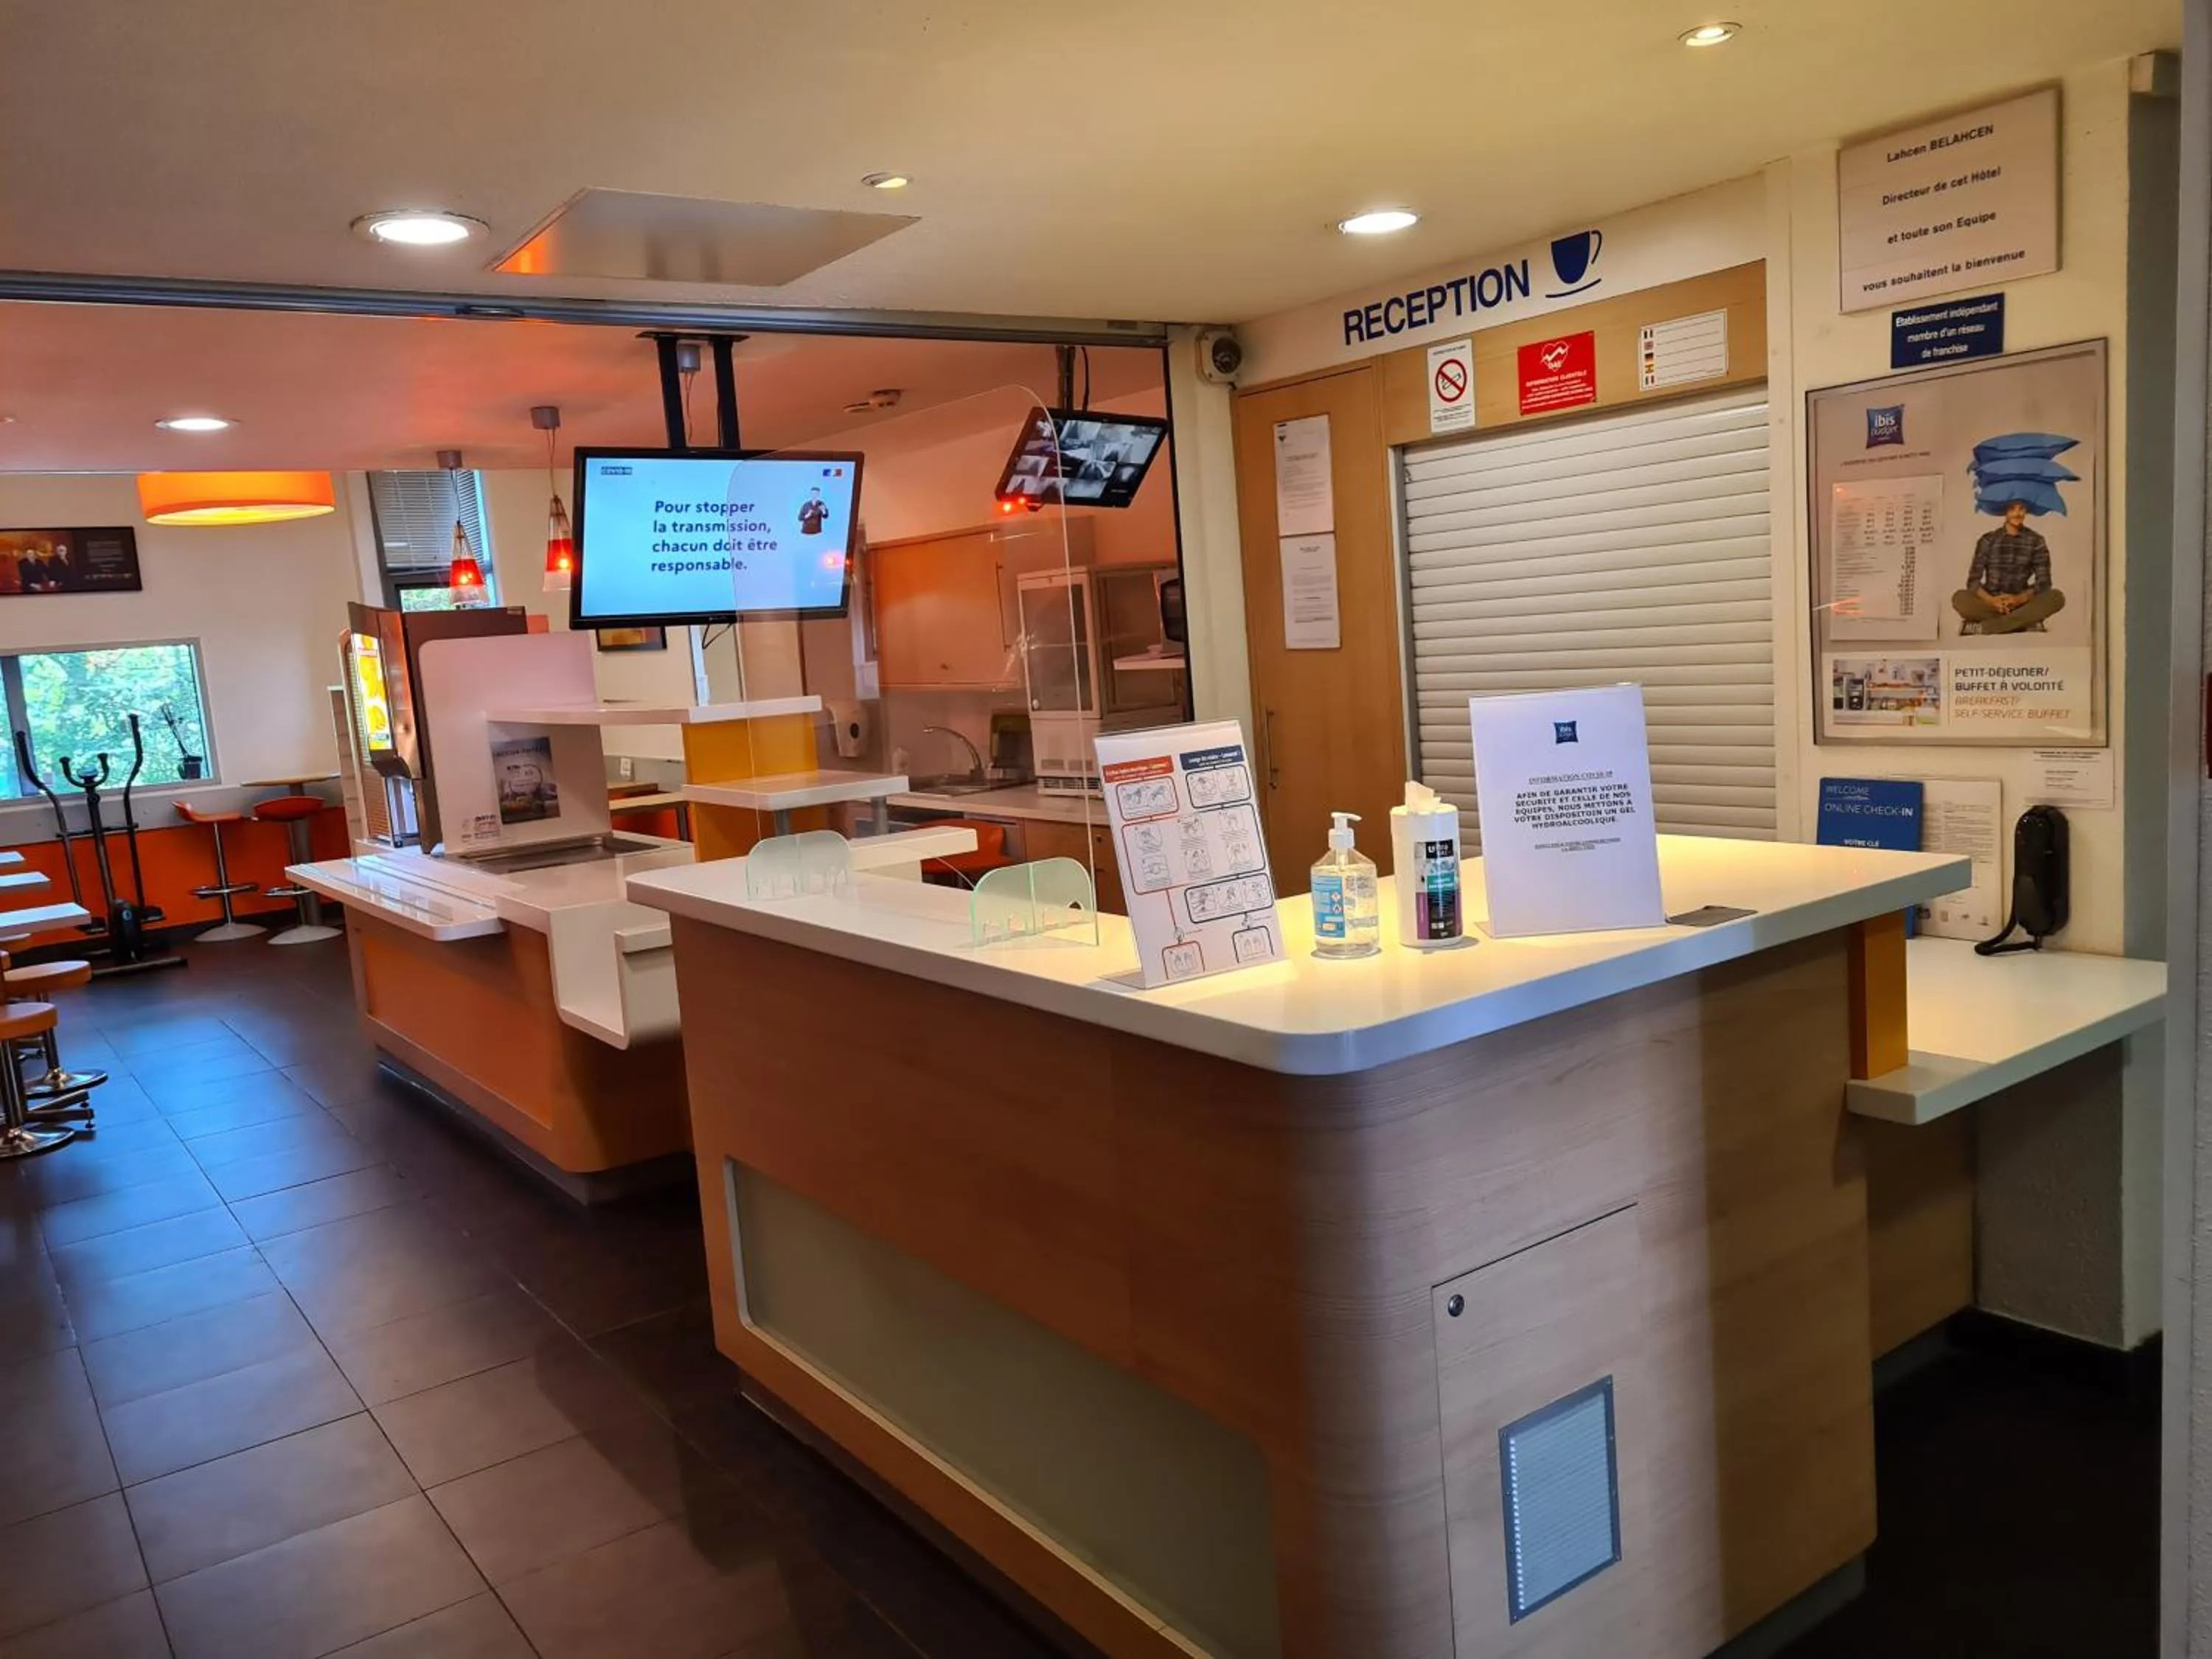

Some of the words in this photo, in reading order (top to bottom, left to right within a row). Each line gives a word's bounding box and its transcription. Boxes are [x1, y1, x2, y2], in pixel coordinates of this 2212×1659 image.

[1887, 145, 1927, 162] Lahcen
[1930, 125, 1994, 151] BELAHCEN
[1882, 187, 1930, 206] Directeur
[1934, 181, 1947, 192] de
[1950, 176, 1969, 188] cet
[1971, 166, 2001, 182] Hôtel
[1887, 234, 1898, 244] et
[1901, 226, 1929, 241] toute
[1933, 221, 1952, 233] son
[1956, 212, 1996, 229] Equipe
[1863, 280, 1888, 292] vous
[1891, 265, 1948, 286] souhaitent
[1952, 262, 1961, 273] la
[1966, 249, 2026, 270] bienvenue
[1343, 259, 1530, 347] RECEPTION
[1875, 414, 1896, 427] ibis
[655, 500, 691, 514] Pour
[695, 501, 755, 517] stopper
[653, 519, 667, 532] la
[672, 518, 771, 534] transmission,
[652, 538, 708, 553] chacun
[712, 538, 742, 552] doit
[747, 538, 778, 552] être
[650, 558, 747, 575] responsable.
[1955, 681, 1997, 692] BUFFET
[2011, 679, 2065, 691] VOLONTÉ
[2028, 709, 2070, 719] BUFFET
[1554, 786, 1598, 796] GARANTIR
[1599, 783, 1628, 791] VOTRE
[1572, 793, 1596, 802] CELLE
[1613, 791, 1631, 799] NOS
[1826, 785, 1869, 796] WELCOME
[1585, 799, 1624, 809] METTONS
[1824, 802, 1862, 814] ONLINE
[1863, 804, 1913, 817] CHECK-IN
[1514, 814, 1542, 823] VOTRE
